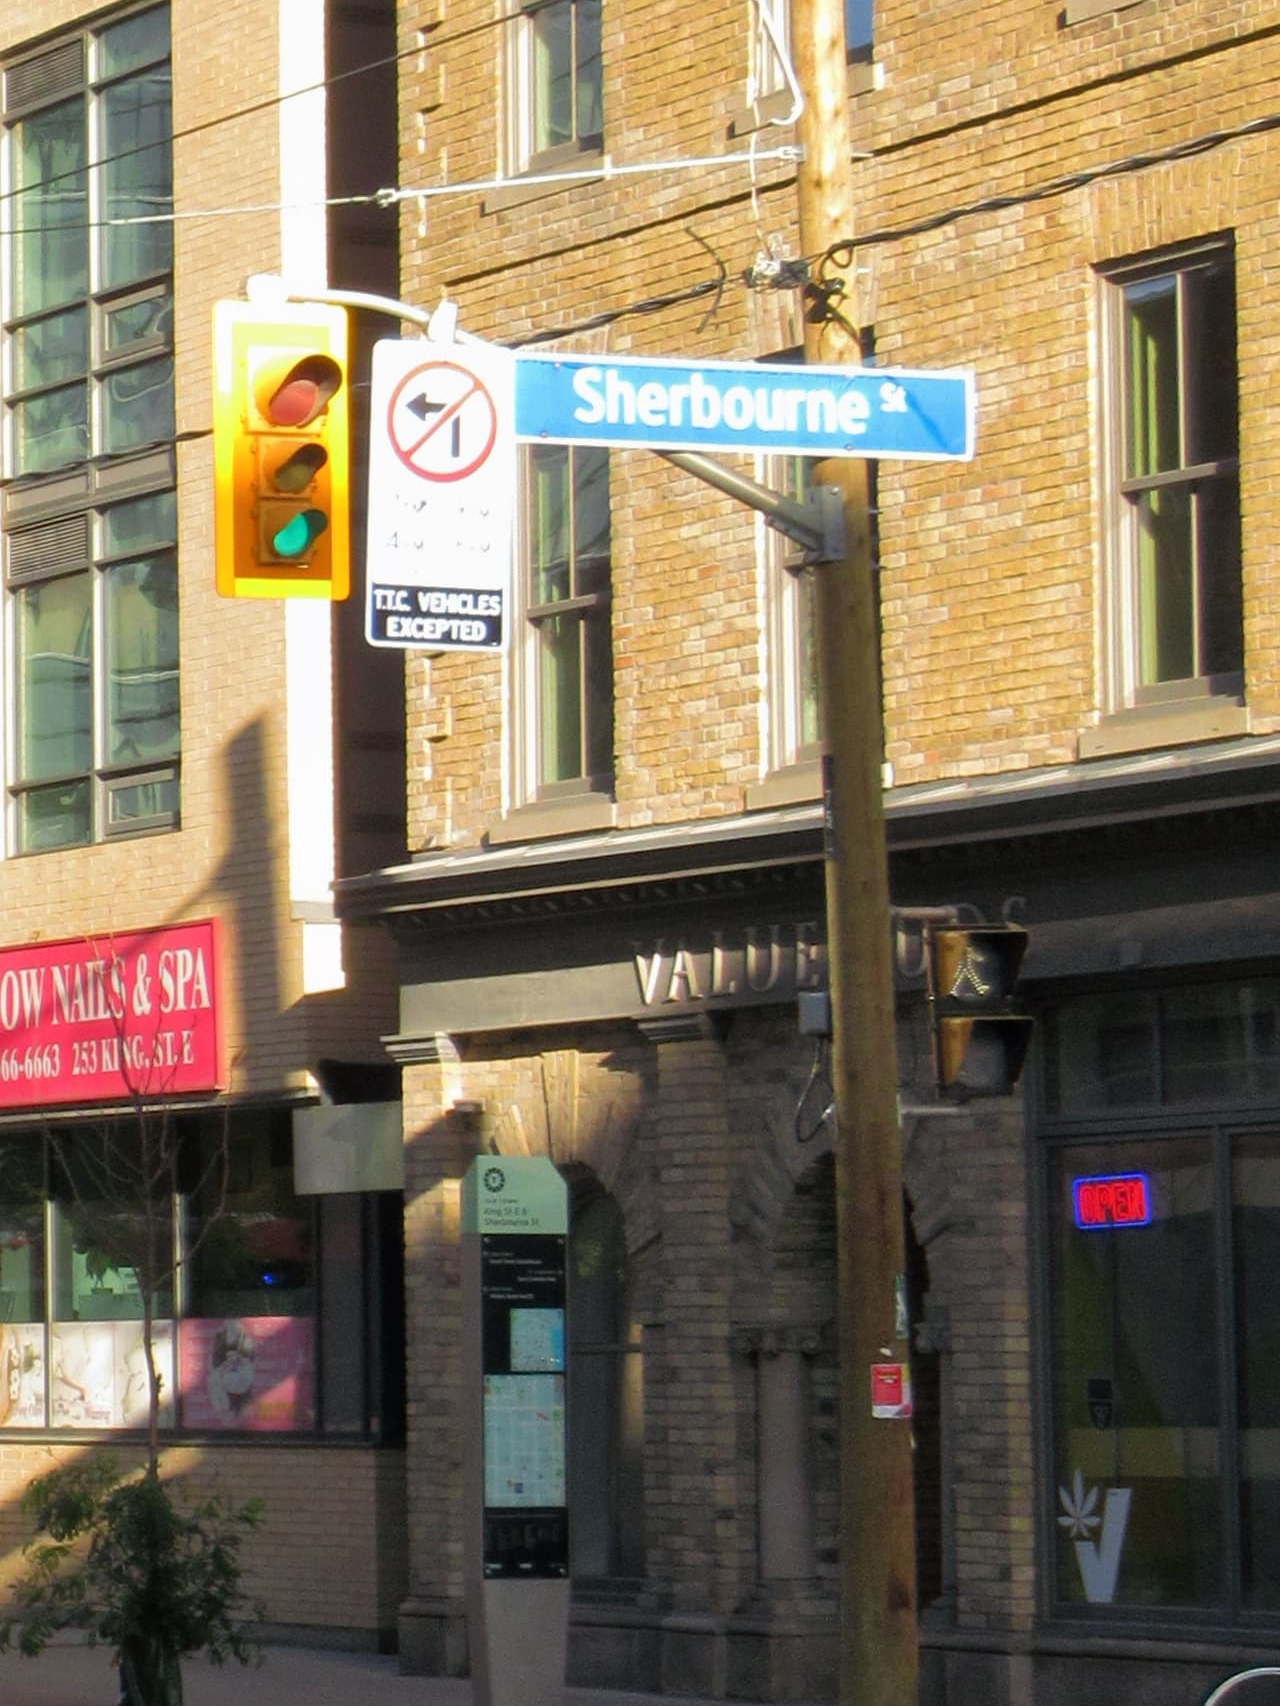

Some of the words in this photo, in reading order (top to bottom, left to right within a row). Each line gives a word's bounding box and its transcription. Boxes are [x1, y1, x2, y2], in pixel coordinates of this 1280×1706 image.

[572, 366, 871, 436] Sherbourne
[879, 382, 909, 413] St
[417, 592, 501, 617] VEHICLES
[385, 616, 487, 642] EXCEPTED
[631, 920, 822, 1006] VALUE
[50, 957, 127, 1026] NAILS
[132, 952, 152, 1017] &
[158, 947, 211, 1014] SPA
[71, 1039, 98, 1077] 253
[1079, 1180, 1146, 1224] OPEN
